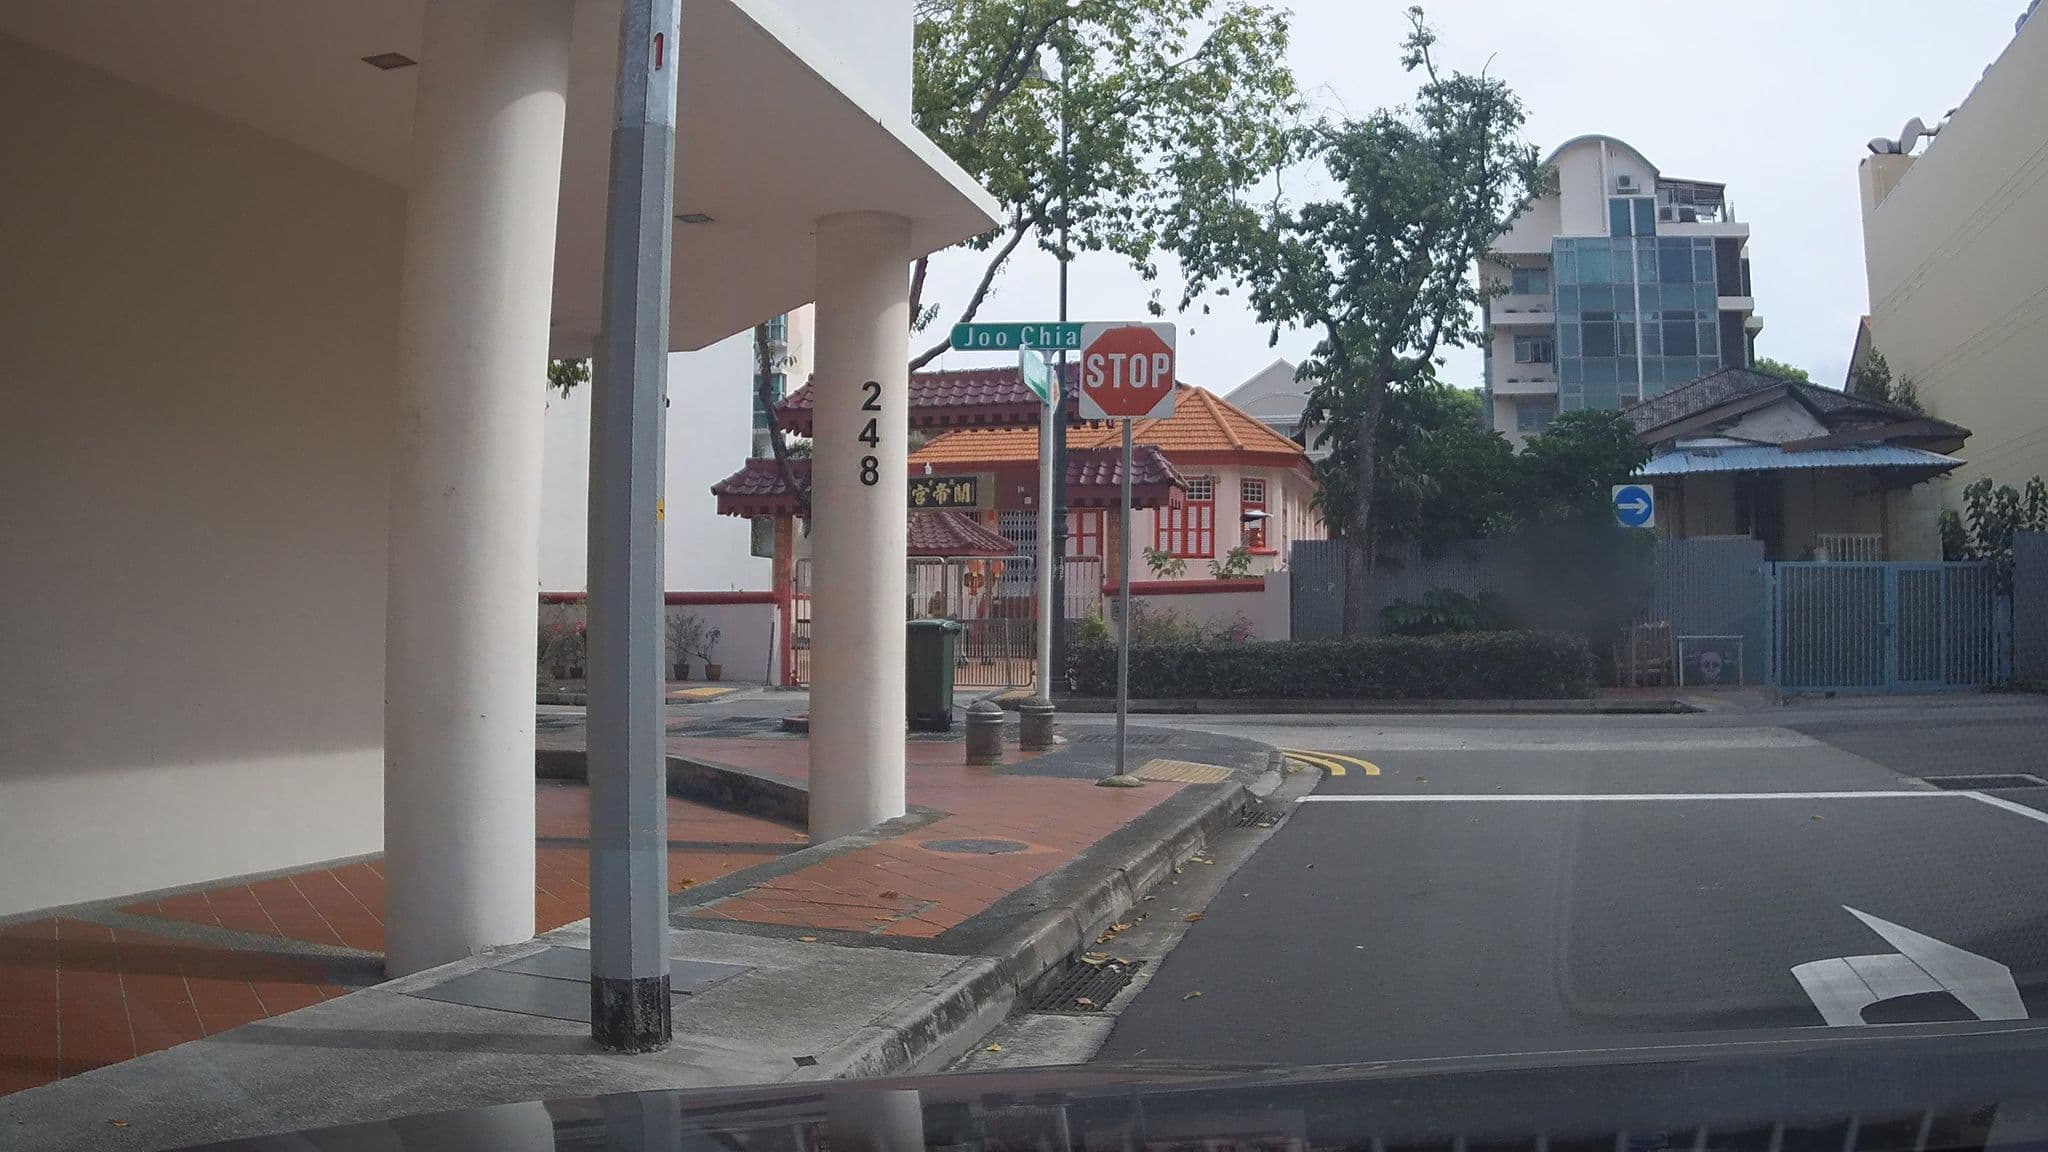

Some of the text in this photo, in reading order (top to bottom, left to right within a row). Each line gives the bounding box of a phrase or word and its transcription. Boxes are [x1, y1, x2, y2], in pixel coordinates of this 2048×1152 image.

[964, 328, 1008, 347] Joo
[1086, 353, 1170, 388] STOP
[858, 380, 882, 486] 248
